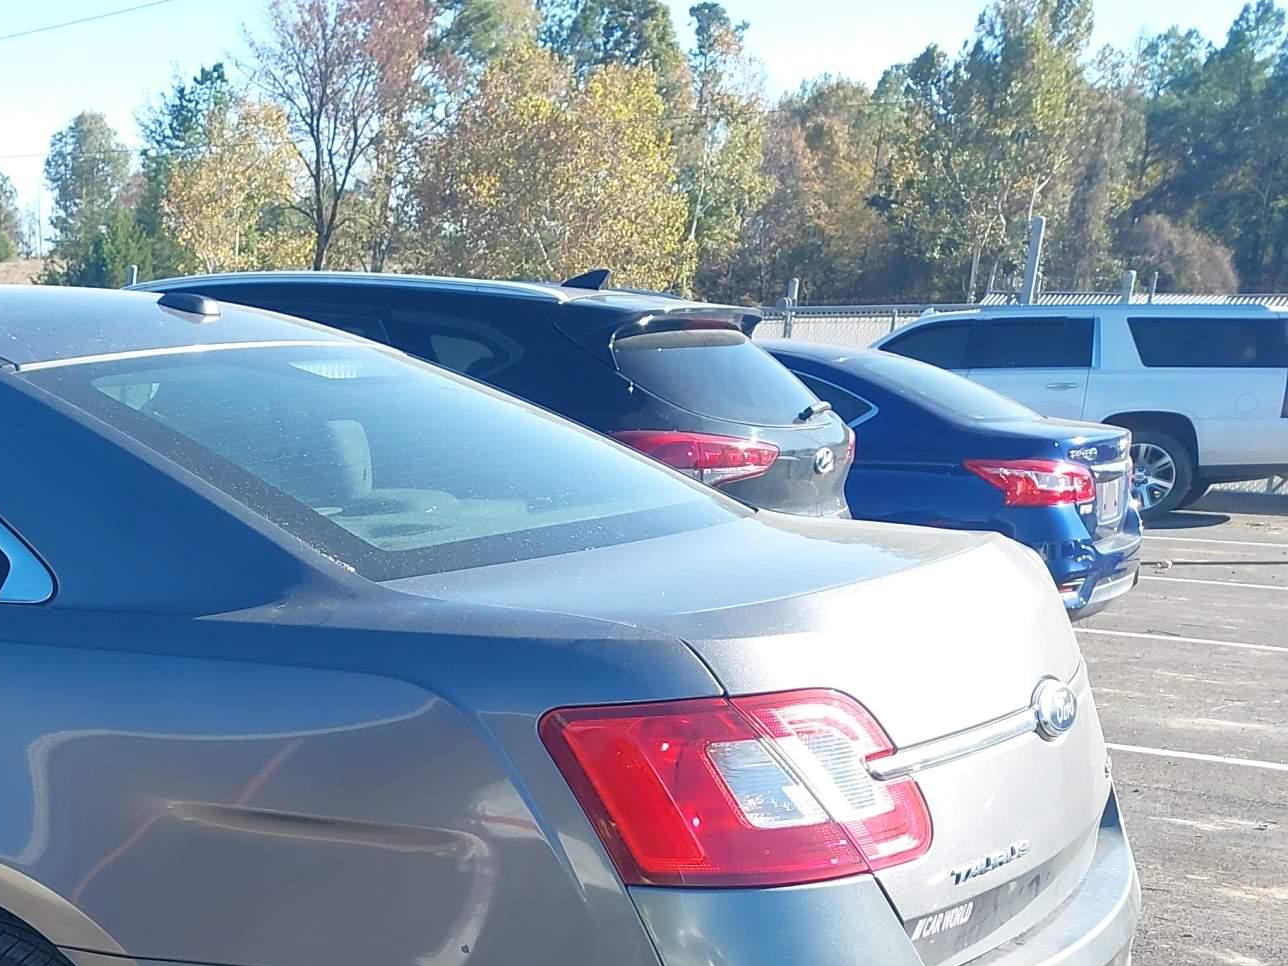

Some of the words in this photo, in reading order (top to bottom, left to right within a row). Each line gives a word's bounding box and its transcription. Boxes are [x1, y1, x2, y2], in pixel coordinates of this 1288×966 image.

[950, 840, 1031, 886] TAURUS
[922, 912, 944, 938] CAR
[941, 900, 974, 932] WORLD
